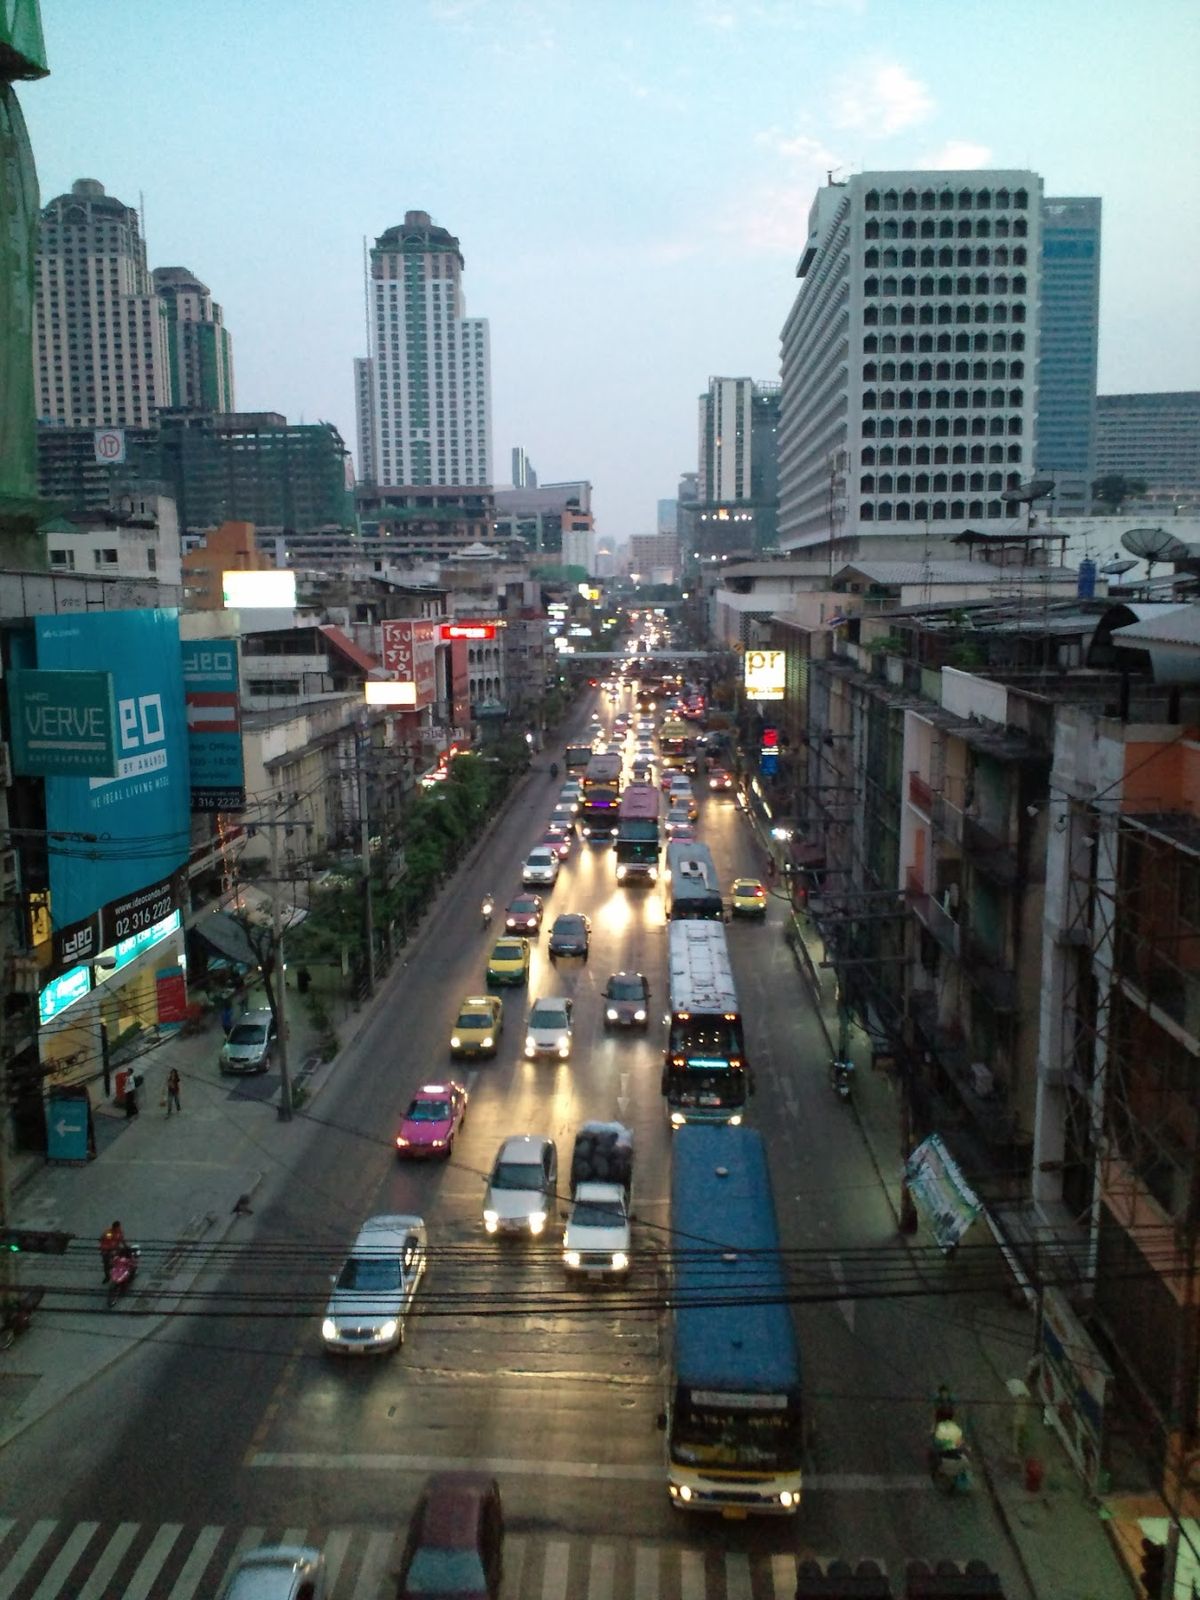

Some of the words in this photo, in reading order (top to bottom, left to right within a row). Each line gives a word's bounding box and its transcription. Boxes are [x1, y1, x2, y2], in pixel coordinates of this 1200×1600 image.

[384, 624, 412, 642] โรง
[183, 652, 233, 671] deo
[25, 706, 104, 737] VERVE
[118, 693, 165, 750] eo
[126, 781, 153, 799] LIVING
[198, 797, 215, 808] 316
[115, 918, 130, 937] 02
[132, 908, 151, 929] 316
[152, 896, 172, 920] 2222
